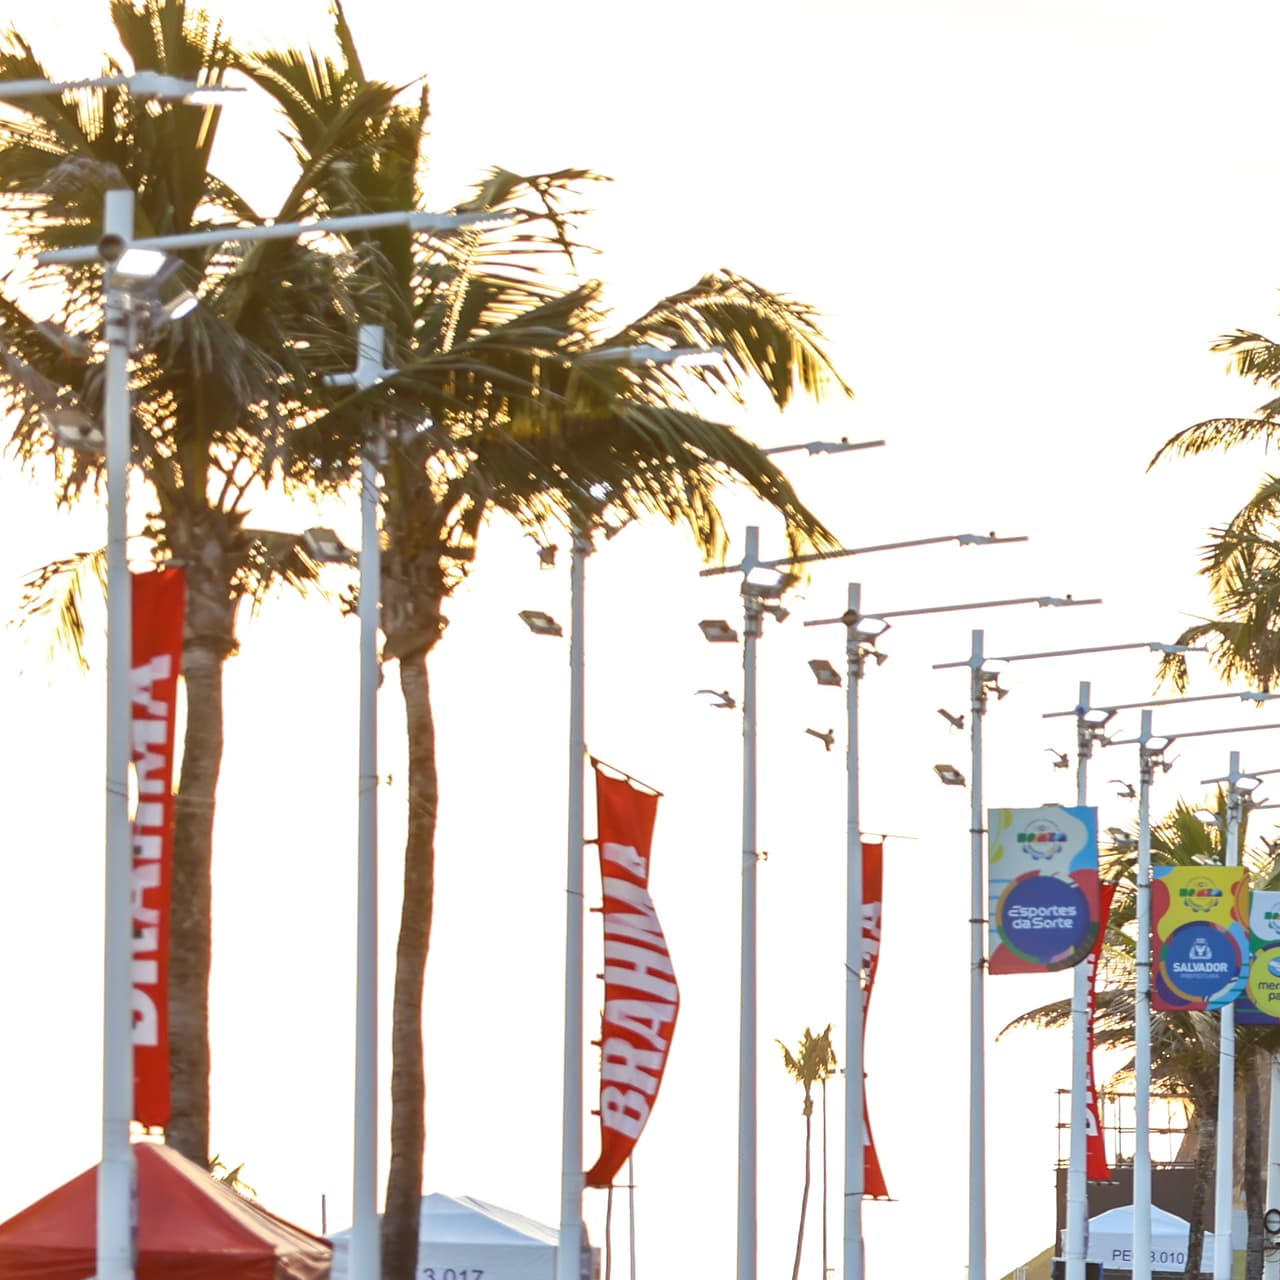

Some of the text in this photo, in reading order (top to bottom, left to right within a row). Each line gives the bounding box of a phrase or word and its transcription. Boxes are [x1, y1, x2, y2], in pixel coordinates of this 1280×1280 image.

[1008, 905, 1077, 918] Esportes
[1173, 962, 1228, 973] SALVADOR
[601, 841, 679, 1139] BRAHMA
[1112, 1249, 1132, 1262] PE
